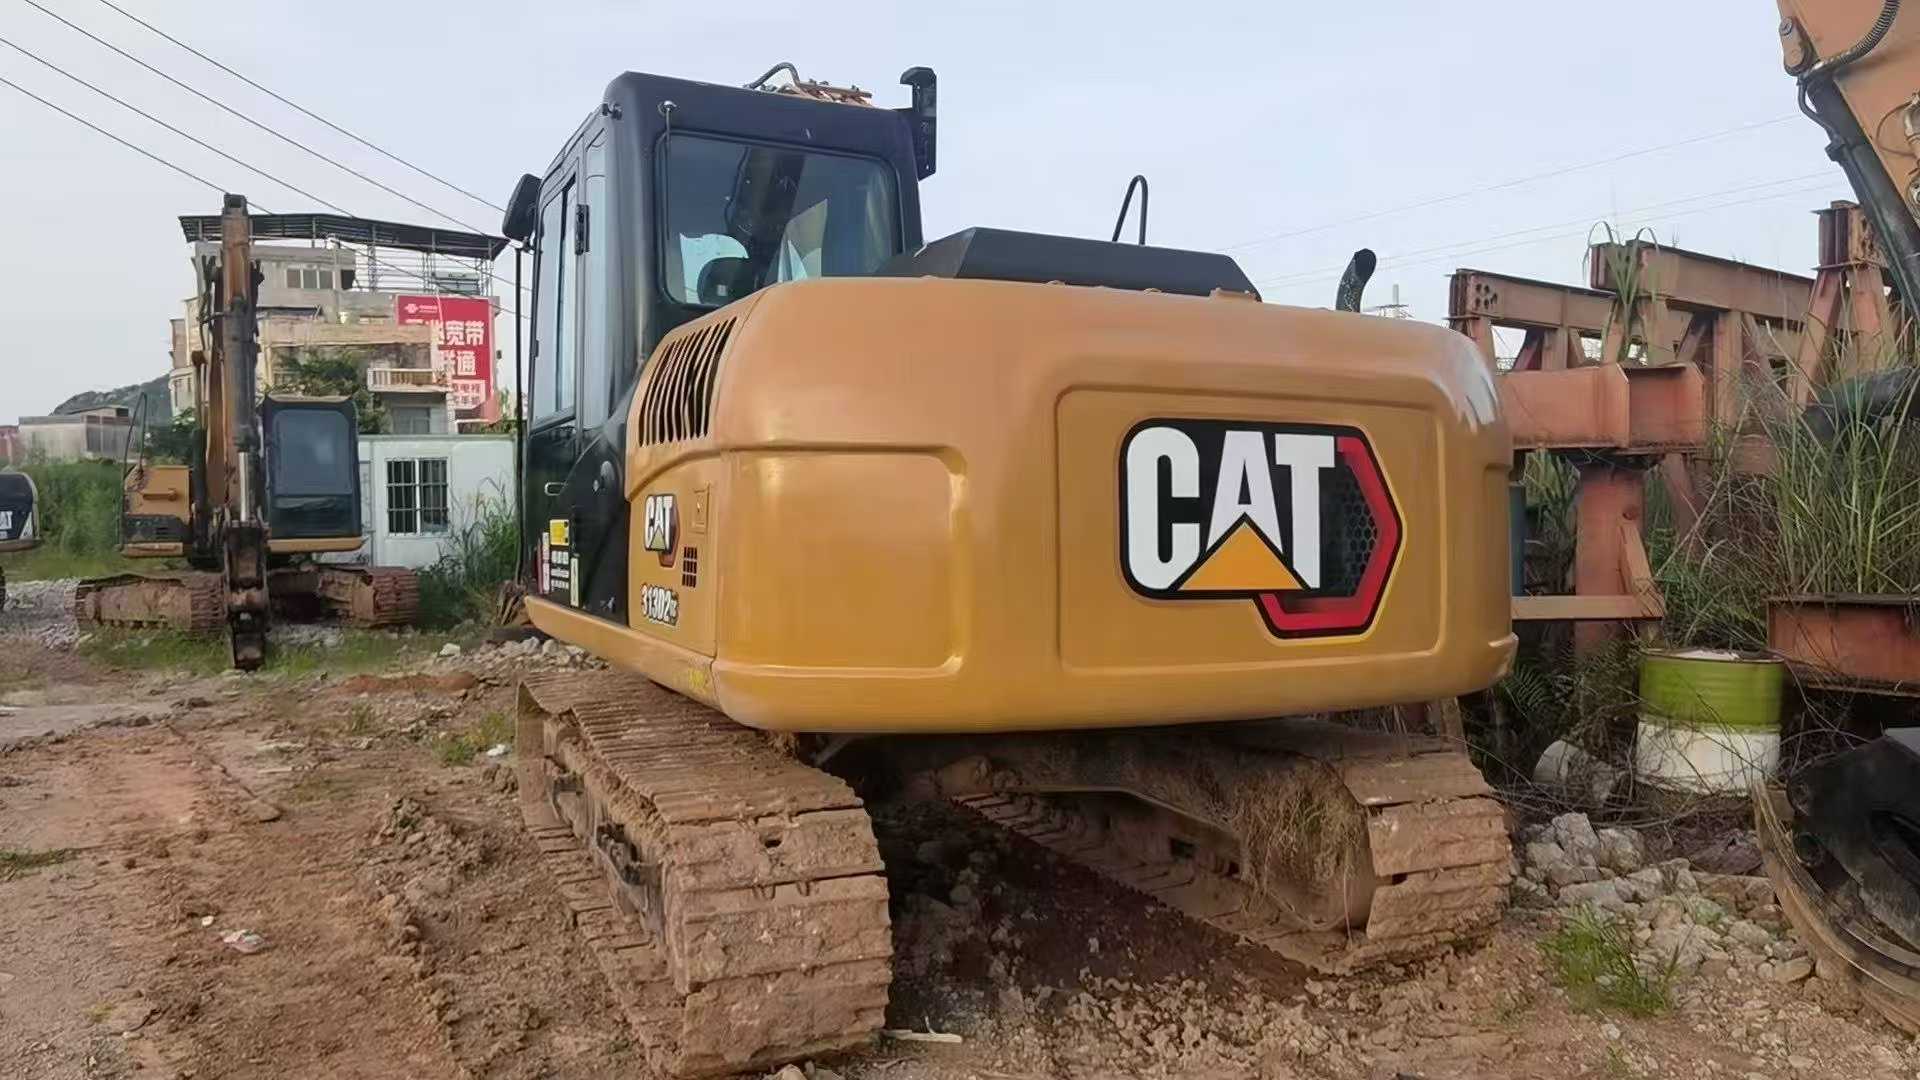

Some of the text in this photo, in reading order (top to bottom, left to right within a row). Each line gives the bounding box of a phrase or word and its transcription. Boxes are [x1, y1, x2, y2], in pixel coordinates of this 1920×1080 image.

[0, 510, 13, 530] AT
[645, 495, 674, 550] CAT
[1126, 426, 1336, 590] CAT
